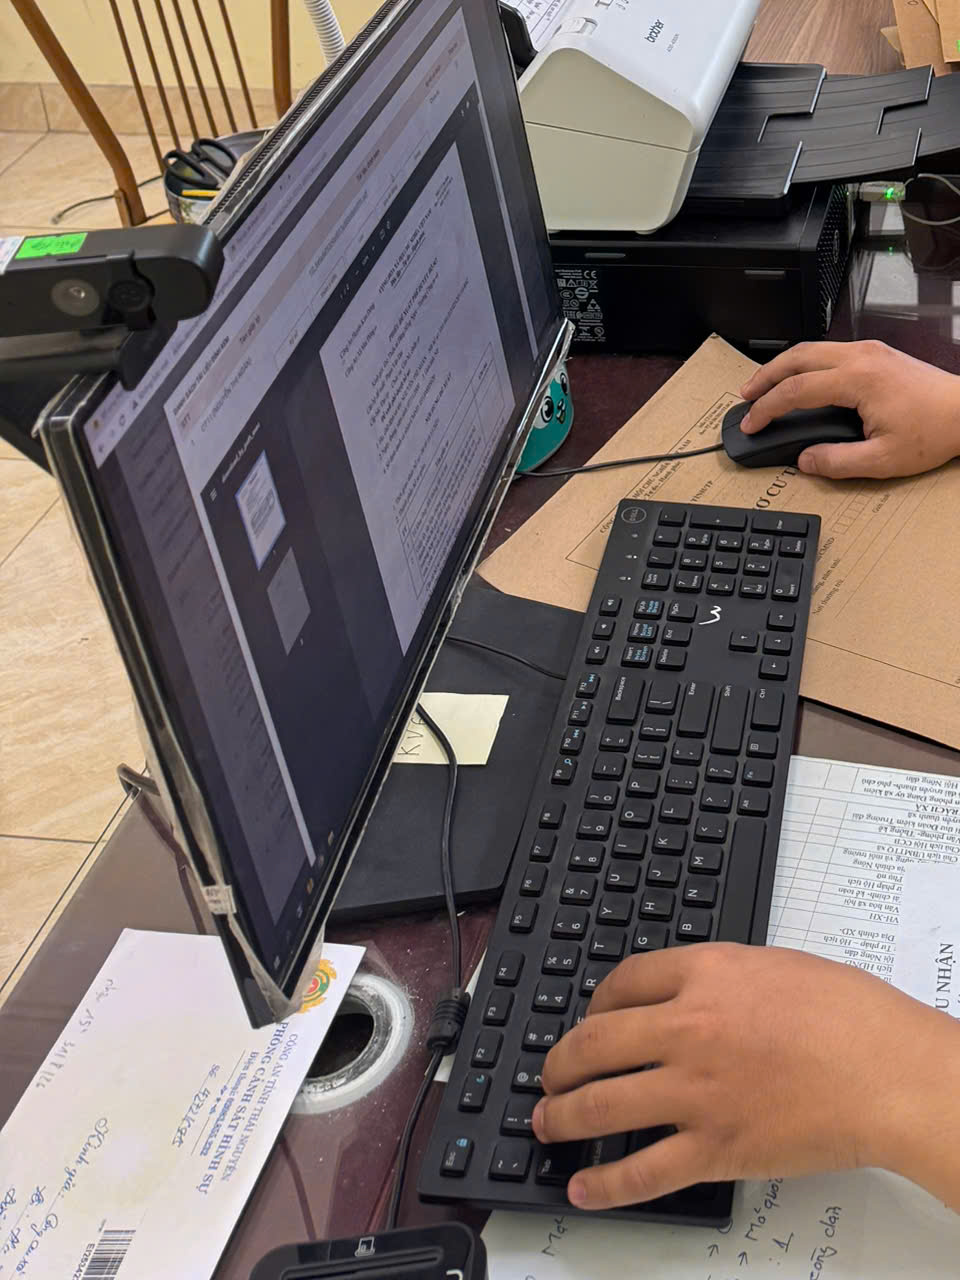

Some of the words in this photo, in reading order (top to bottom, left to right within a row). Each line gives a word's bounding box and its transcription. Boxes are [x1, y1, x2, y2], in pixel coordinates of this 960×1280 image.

[644, 19, 664, 43] brother
[660, 648, 669, 663] Delete
[615, 676, 627, 701] Backspace
[724, 684, 732, 697] Shift
[693, 856, 704, 865] M
[644, 902, 655, 911] H
[682, 923, 692, 931] B
[499, 967, 508, 977] F4
[934, 942, 956, 992] NHẬN
[258, 1018, 288, 1067] PHÒNG
[277, 1031, 299, 1062] CÔNG
[240, 1065, 266, 1106] CẢNH
[257, 1076, 278, 1106] TỈNH
[464, 1092, 473, 1103] F1
[226, 1102, 248, 1132] SÁT
[243, 1103, 264, 1134] THÁI
[206, 1132, 233, 1173] HÌNH
[220, 1132, 250, 1183] NGUYÊN
[194, 1170, 215, 1195] SỰ
